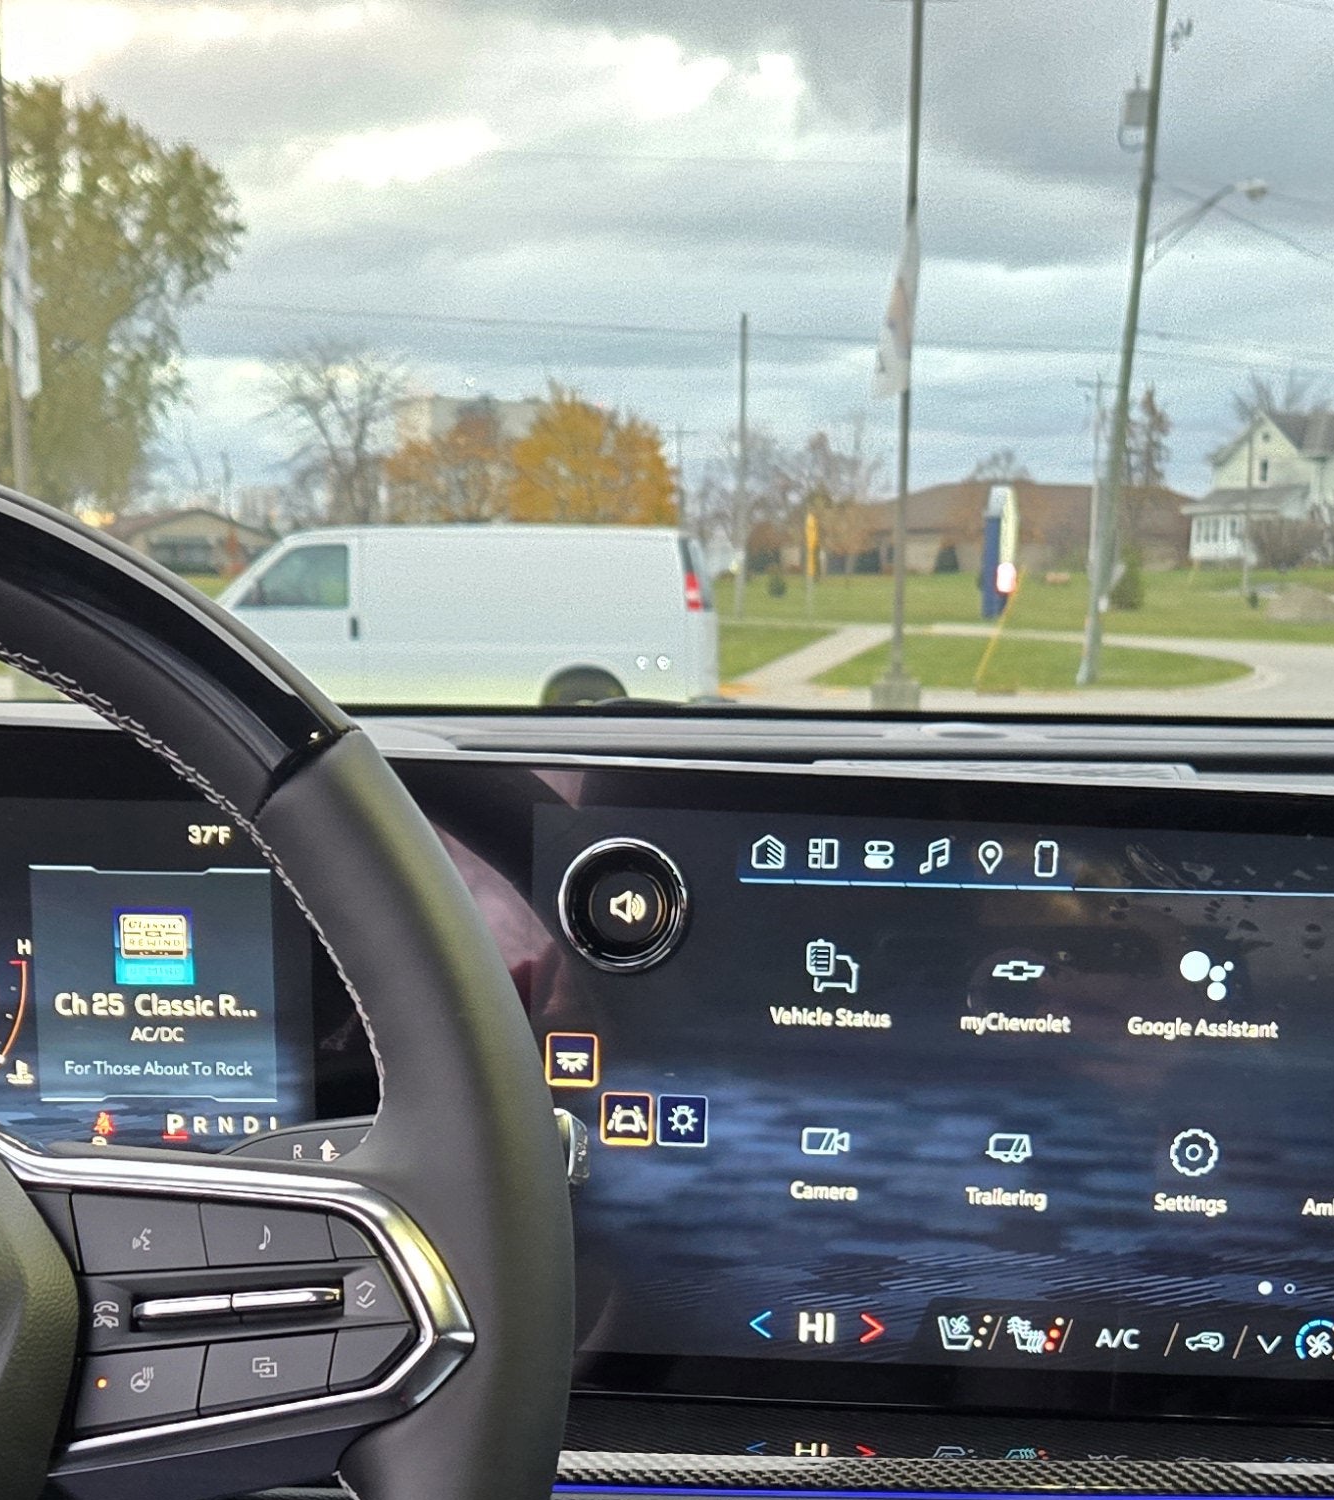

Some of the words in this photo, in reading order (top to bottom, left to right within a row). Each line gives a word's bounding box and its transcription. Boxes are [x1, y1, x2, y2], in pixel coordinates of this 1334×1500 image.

[17, 938, 31, 955] H
[54, 991, 87, 1016] Ch
[92, 992, 125, 1016] 25
[134, 992, 215, 1017] Classic
[769, 1006, 832, 1027] Vehicle
[835, 1008, 891, 1029] Status
[960, 1013, 1071, 1035] myChevrolet
[1127, 1016, 1192, 1040] Google
[1194, 1018, 1279, 1039] Assistant
[130, 1026, 185, 1042] AC/DC
[64, 1060, 91, 1076] For
[93, 1060, 141, 1076] Those
[143, 1061, 189, 1076] About
[191, 1061, 212, 1076] To
[215, 1061, 253, 1077] Rock
[166, 1113, 185, 1135] P
[193, 1115, 208, 1134] R
[217, 1115, 234, 1134] N
[243, 1115, 260, 1134] D
[292, 1143, 303, 1160] R
[790, 1180, 858, 1202] Camera
[965, 1186, 1048, 1212] Trailering
[1153, 1192, 1228, 1217] Settings
[798, 1311, 836, 1344] HI
[1095, 1328, 1141, 1350] A/C
